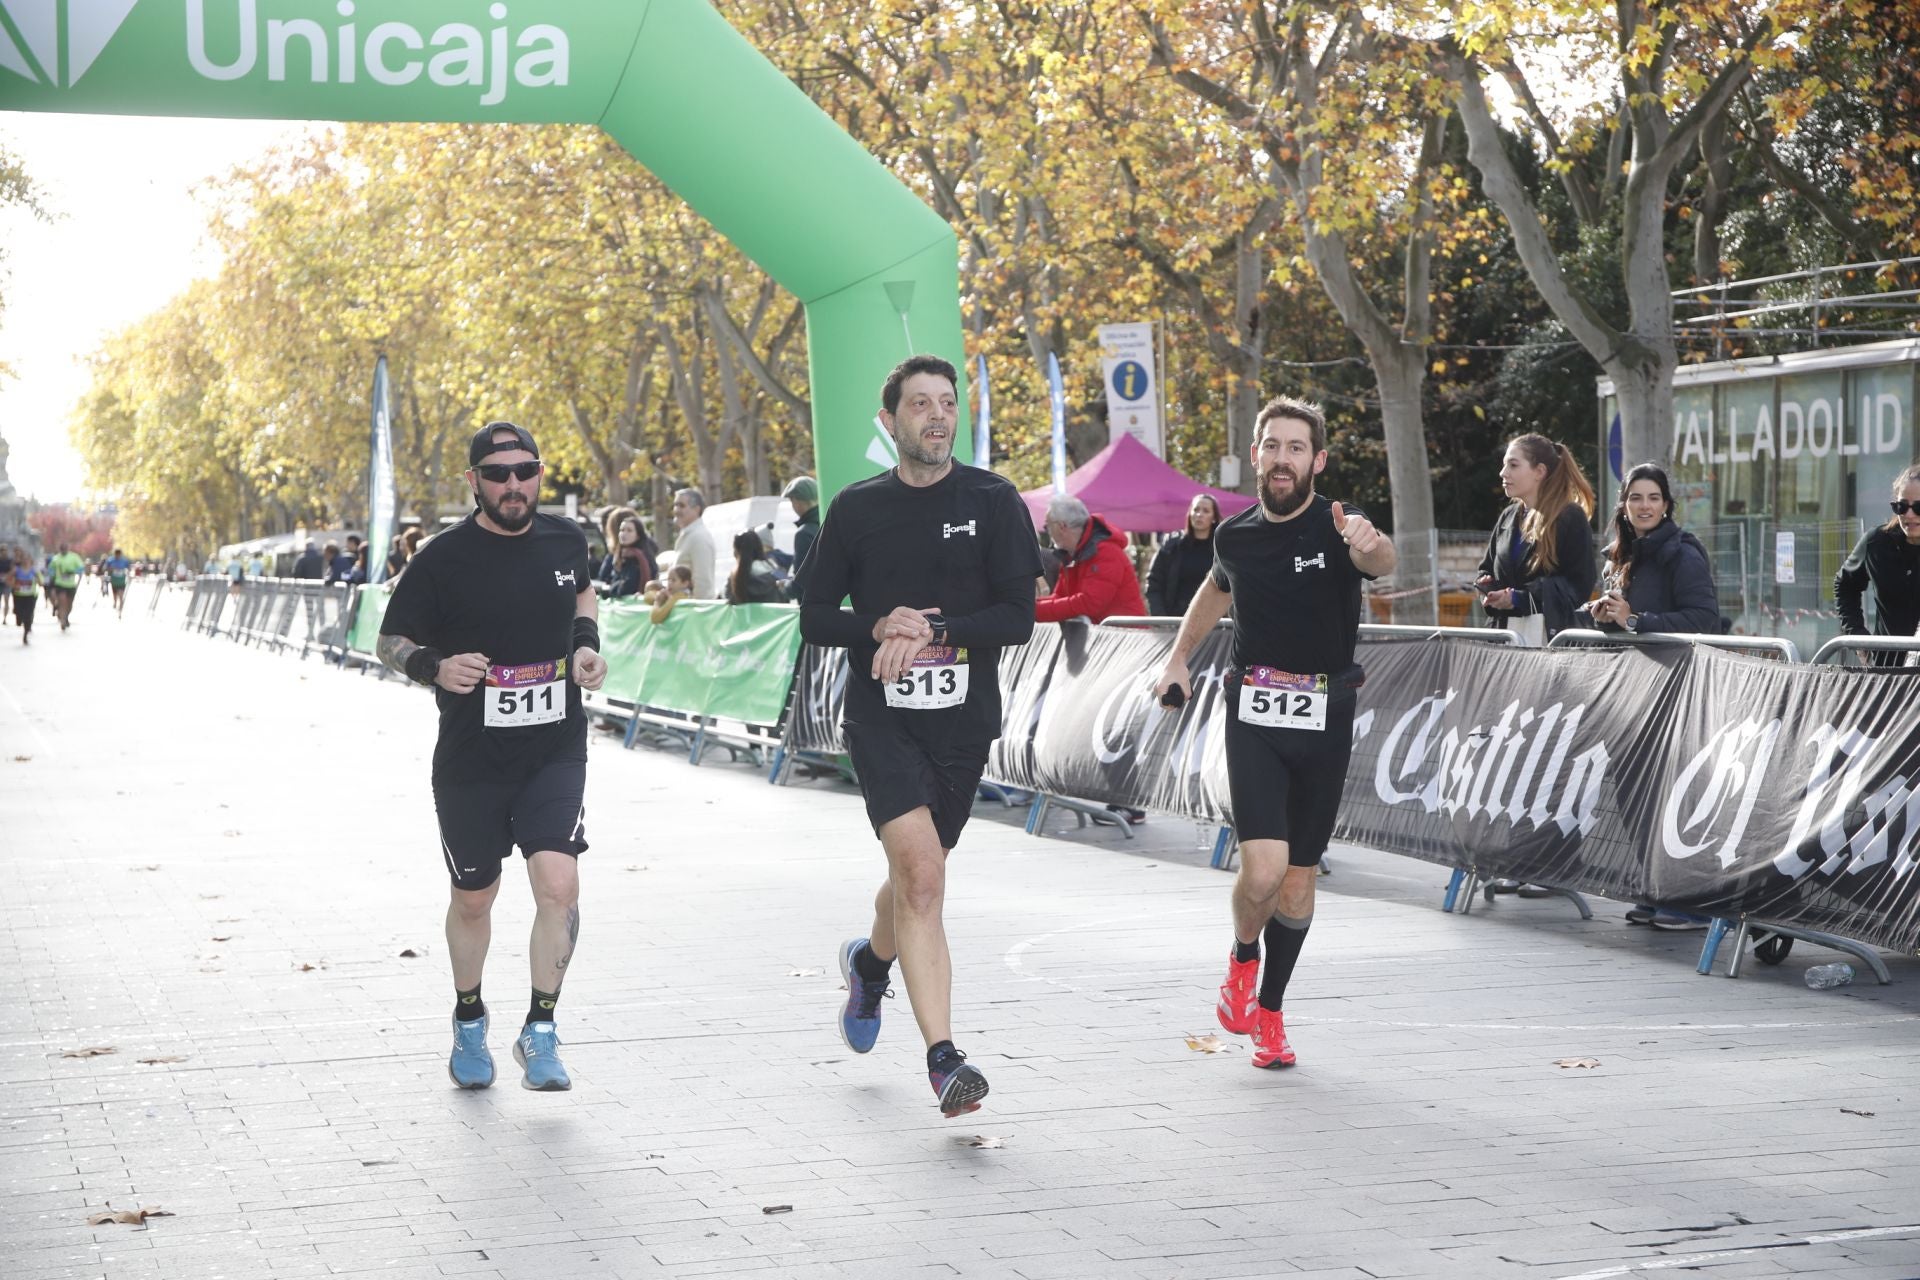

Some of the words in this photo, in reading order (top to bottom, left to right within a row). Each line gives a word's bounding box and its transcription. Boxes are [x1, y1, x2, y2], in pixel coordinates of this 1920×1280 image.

[186, 0, 569, 106] Unicaja
[944, 520, 976, 538] HORSE
[1295, 553, 1325, 572] HORSE
[916, 651, 944, 660] MPRESAS
[896, 668, 957, 697] 513
[497, 685, 552, 715] 511
[1251, 689, 1312, 718] 512
